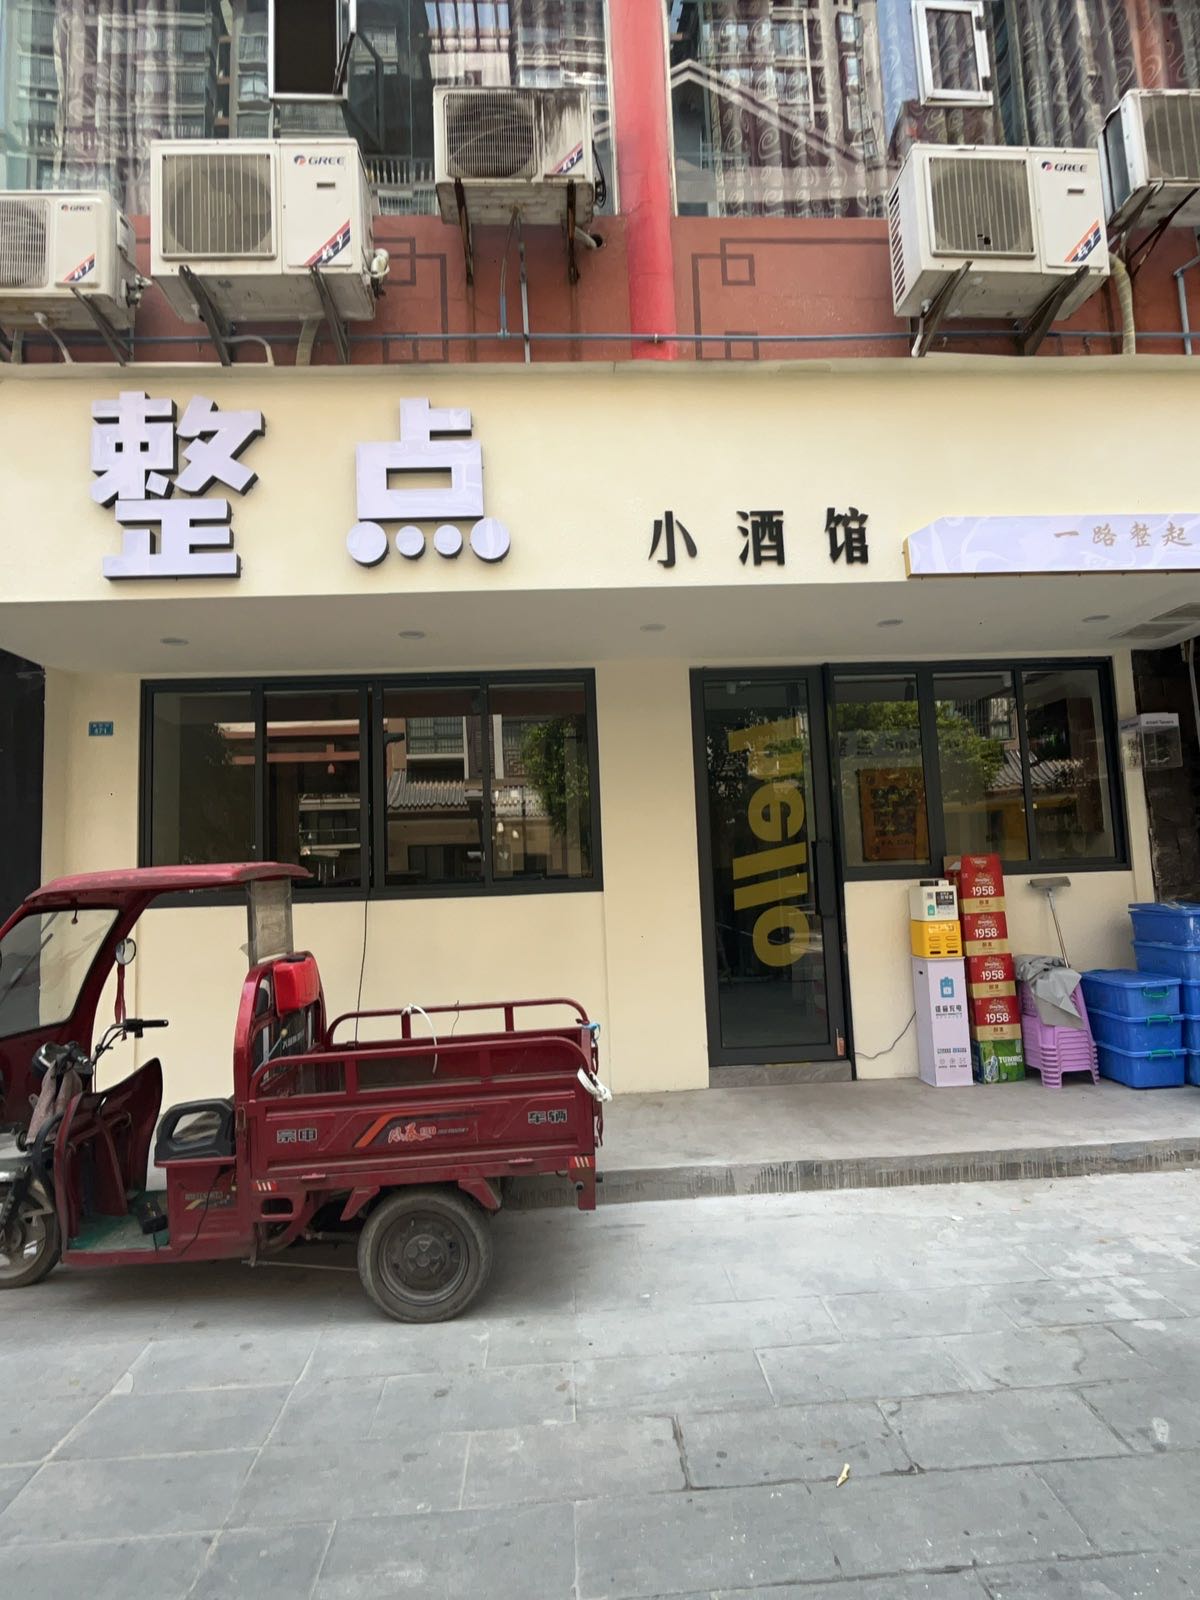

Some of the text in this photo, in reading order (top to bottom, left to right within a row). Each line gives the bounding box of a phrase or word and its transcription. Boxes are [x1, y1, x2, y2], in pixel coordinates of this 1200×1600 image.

[308, 156, 345, 166] GREE
[1054, 163, 1088, 173] GREE
[89, 391, 511, 580] 整点
[648, 506, 870, 568] 小酒馆
[1053, 520, 1194, 548] 一路整起
[971, 885, 995, 896] 1958
[974, 928, 998, 938] 1958
[981, 970, 1005, 981] 1958
[985, 1012, 1010, 1023] 1958
[276, 1128, 318, 1144] 宗申
